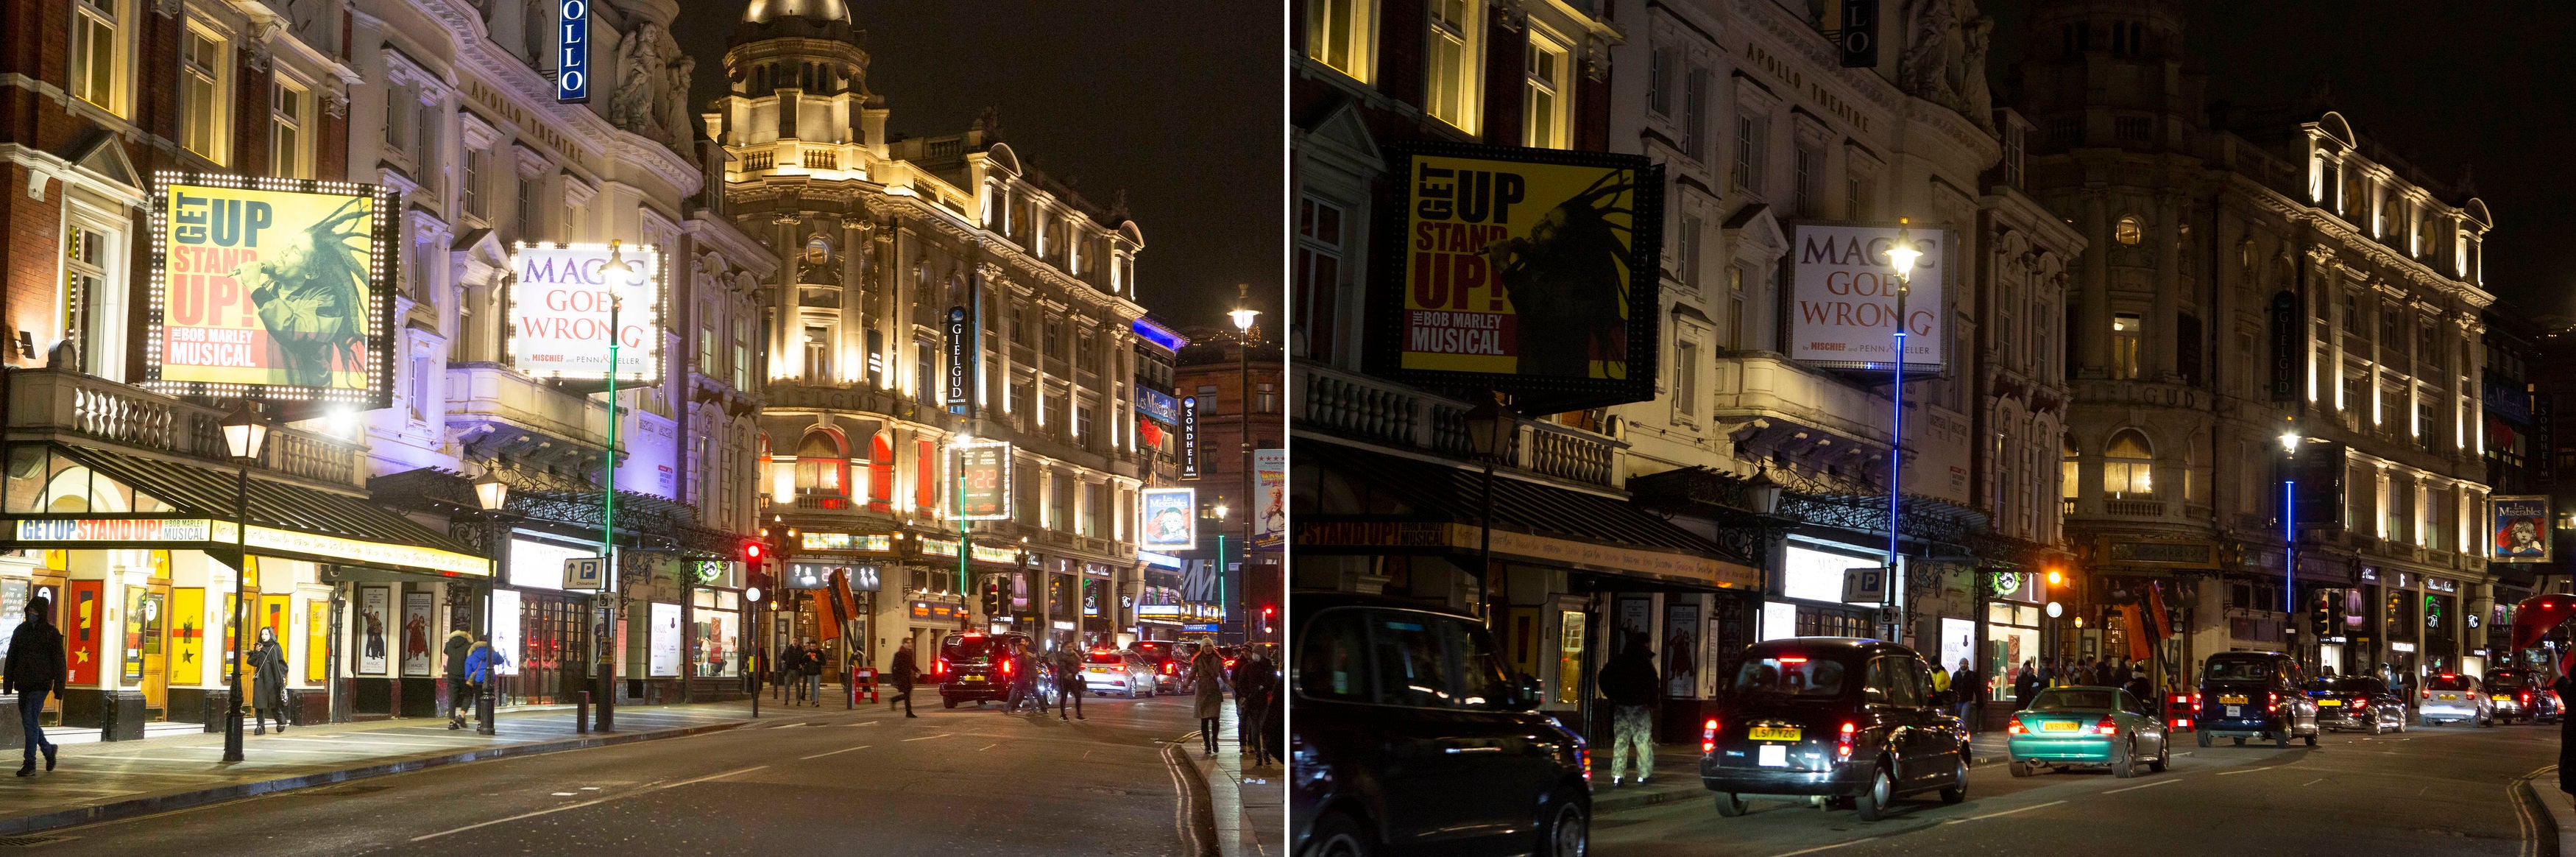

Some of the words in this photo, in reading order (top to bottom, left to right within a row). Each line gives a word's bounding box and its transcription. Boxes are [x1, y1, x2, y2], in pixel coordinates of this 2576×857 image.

[1747, 42, 1801, 89] APOLLO
[1812, 82, 1869, 133] THEATRE
[472, 81, 521, 124] APOLLO
[531, 118, 583, 164] THEATRE
[1417, 162, 1454, 220] GET
[1457, 169, 1525, 224] UP
[175, 191, 208, 244] GET
[211, 198, 272, 247] UP
[1800, 234, 1936, 269] MAGC
[523, 256, 645, 286] MAGC
[1414, 253, 1504, 311] UP!
[173, 274, 255, 327] UP!
[1412, 310, 1423, 325] THE
[1424, 311, 1449, 327] BOB
[1453, 313, 1502, 329] MARLEY
[171, 327, 181, 341] THE
[182, 328, 205, 342] BOB
[208, 329, 252, 344] MARLEY
[1412, 327, 1504, 355] MUSICAL
[170, 342, 255, 367] MUSICAL
[532, 354, 564, 362] MISCHIEF
[1811, 342, 1846, 351] MISCHIEF
[1860, 345, 1885, 353] PENN
[1905, 346, 1930, 354] ELLER
[2279, 311, 2289, 393] GIELGUD
[952, 324, 962, 398] GIELGUD
[1136, 387, 1146, 410] Les
[1186, 409, 1194, 472] SONDHEIM
[23, 520, 55, 540] GET
[55, 520, 76, 540] UP
[77, 520, 132, 540] STAND
[134, 520, 162, 540] UP!
[163, 528, 205, 540] MUSICAL
[183, 520, 204, 528] MARLEY
[1306, 521, 1365, 545] STAND
[1368, 521, 1398, 545] UP!
[1420, 523, 1444, 531] MARLEY
[1401, 531, 1445, 545] MUSICAL
[583, 563, 593, 578] P
[1865, 574, 1876, 590] P
